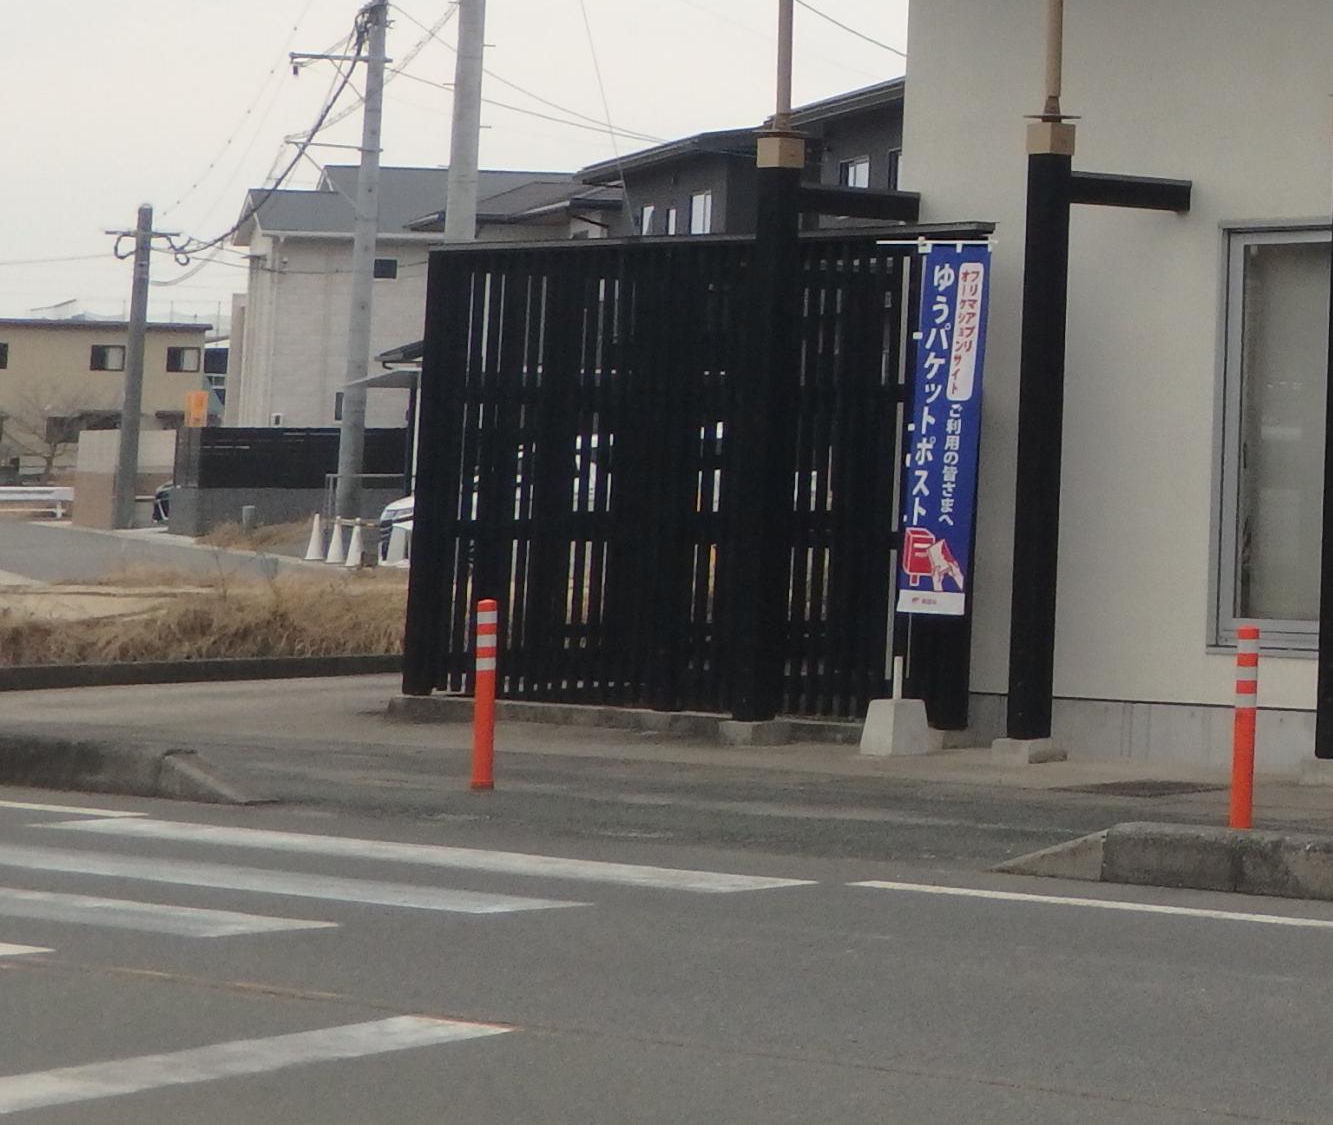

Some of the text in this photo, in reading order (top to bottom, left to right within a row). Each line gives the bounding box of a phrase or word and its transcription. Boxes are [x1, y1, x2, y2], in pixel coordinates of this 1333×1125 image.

[963, 270, 981, 353] フリマアプリ
[912, 263, 956, 527] ゆうパケットポスト
[937, 403, 963, 527] ご利用の皆さまへ
